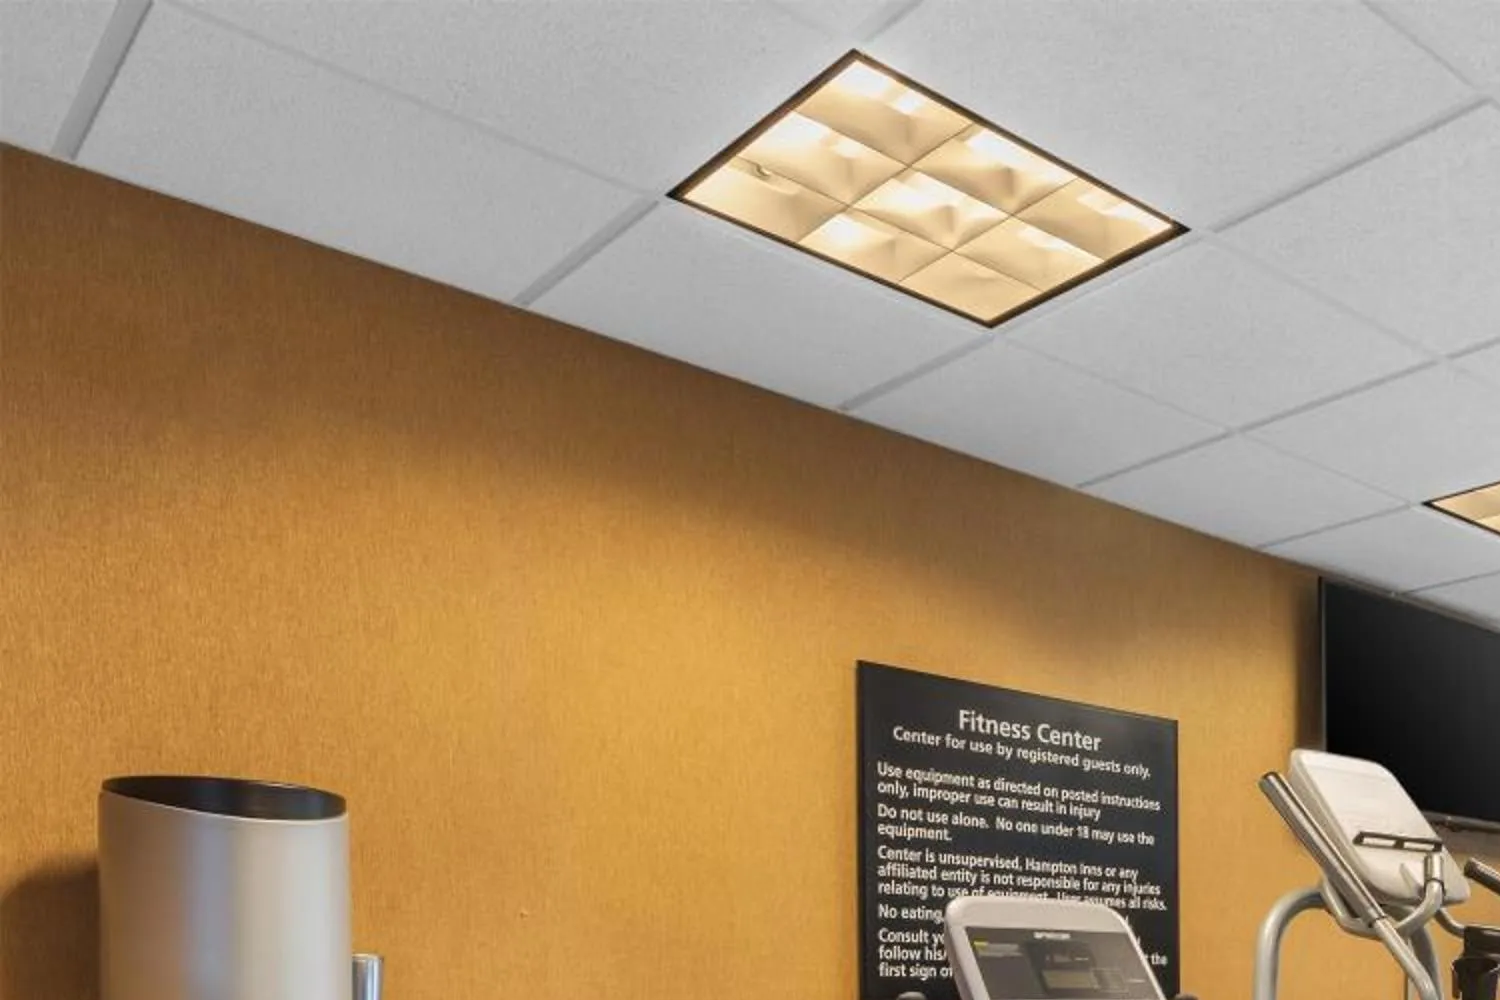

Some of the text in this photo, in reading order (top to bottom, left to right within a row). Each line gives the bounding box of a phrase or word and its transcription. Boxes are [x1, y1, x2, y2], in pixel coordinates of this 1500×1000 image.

[959, 709, 1102, 751] Fitness Center
[893, 726, 940, 746] Center
[945, 733, 966, 750] for
[969, 741, 993, 755] use
[996, 741, 1013, 761] by
[1016, 747, 1079, 767] registered
[1082, 758, 1121, 772] guests
[877, 761, 1160, 811] Use equipment as directed on posted instructions
[913, 783, 971, 804] improper
[974, 794, 995, 805] use
[997, 797, 1018, 809] can
[1021, 799, 1053, 813] result
[1056, 801, 1067, 814] in
[877, 803, 897, 819] Do
[900, 809, 923, 822] not
[927, 811, 949, 824] use
[951, 812, 989, 829] alone.
[995, 817, 1013, 831] No
[1015, 822, 1038, 833] one
[1041, 822, 1074, 837] under
[1091, 829, 1115, 844] may
[1117, 832, 1135, 844] use
[1137, 832, 1155, 845] the
[877, 822, 953, 841] equipment.
[877, 845, 922, 862] Center
[925, 848, 935, 863] is
[1025, 858, 1077, 875] Hampton
[1105, 867, 1117, 877] or
[1119, 868, 1139, 881] any
[877, 863, 1161, 899] affiliated entity is not responsible for any injuries
[878, 880, 928, 900] relating
[931, 884, 945, 898] to
[947, 887, 969, 898] use
[1128, 896, 1140, 909] all
[879, 904, 898, 919] No
[879, 928, 930, 944] Consult
[879, 945, 922, 961] follow
[1151, 953, 1168, 966] the
[879, 963, 907, 978] first
[909, 963, 937, 981] sign
